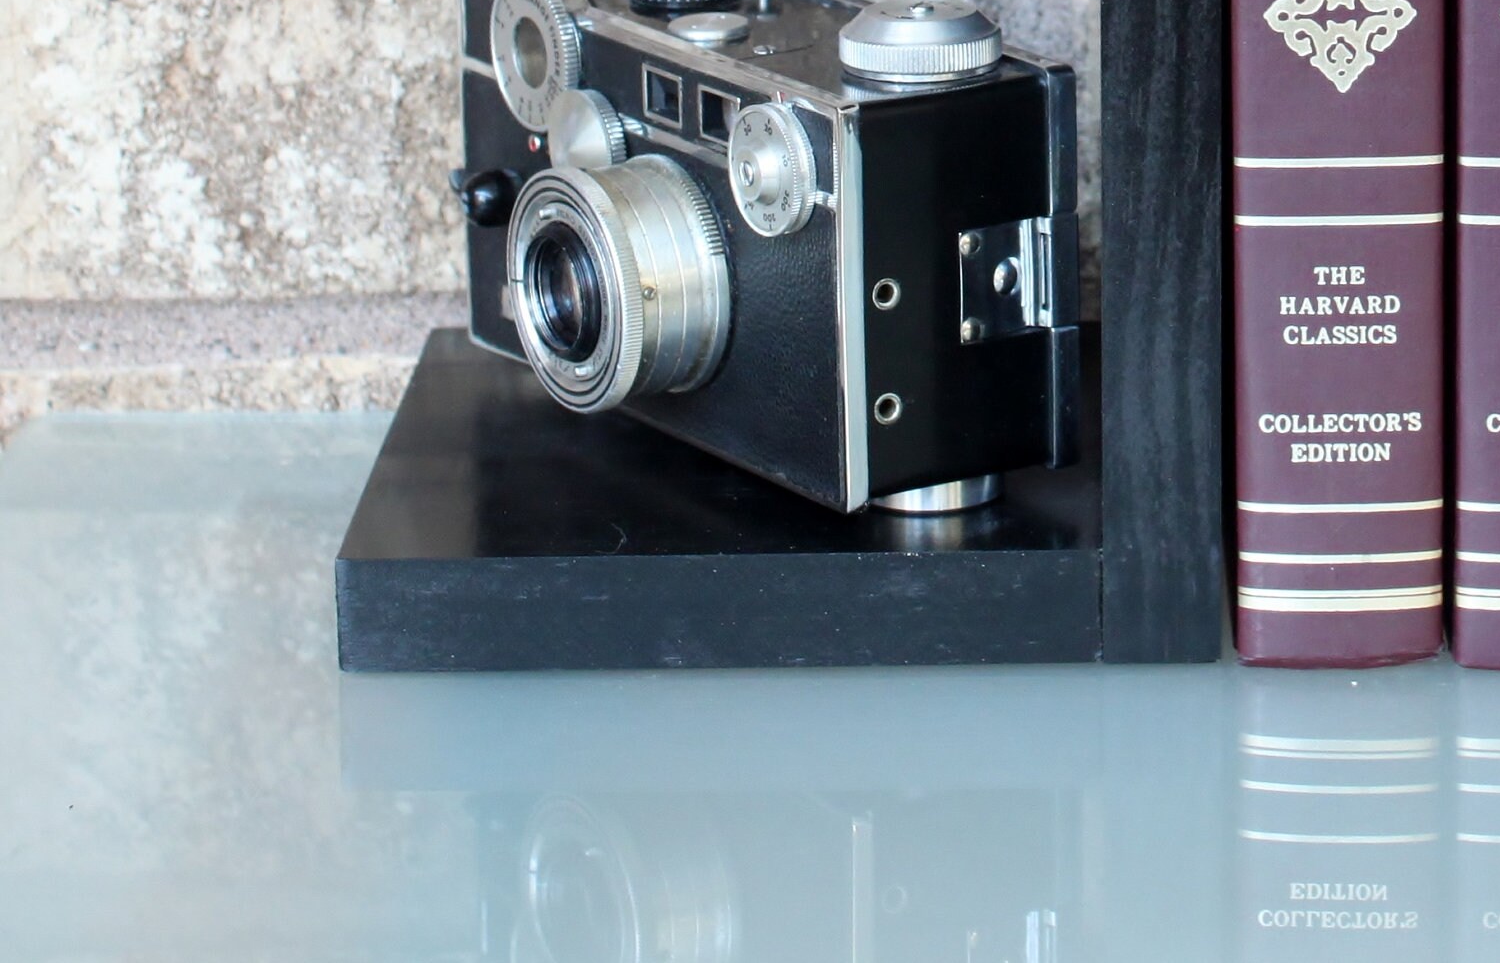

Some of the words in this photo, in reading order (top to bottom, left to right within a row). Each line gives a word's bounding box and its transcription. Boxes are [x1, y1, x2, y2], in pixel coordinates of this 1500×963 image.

[1312, 265, 1366, 286] THE
[1279, 294, 1402, 316] HARVARD
[1282, 323, 1398, 346] CLASSICS
[1257, 411, 1423, 434] COLLECTOR'S
[1289, 441, 1392, 464] EDITION
